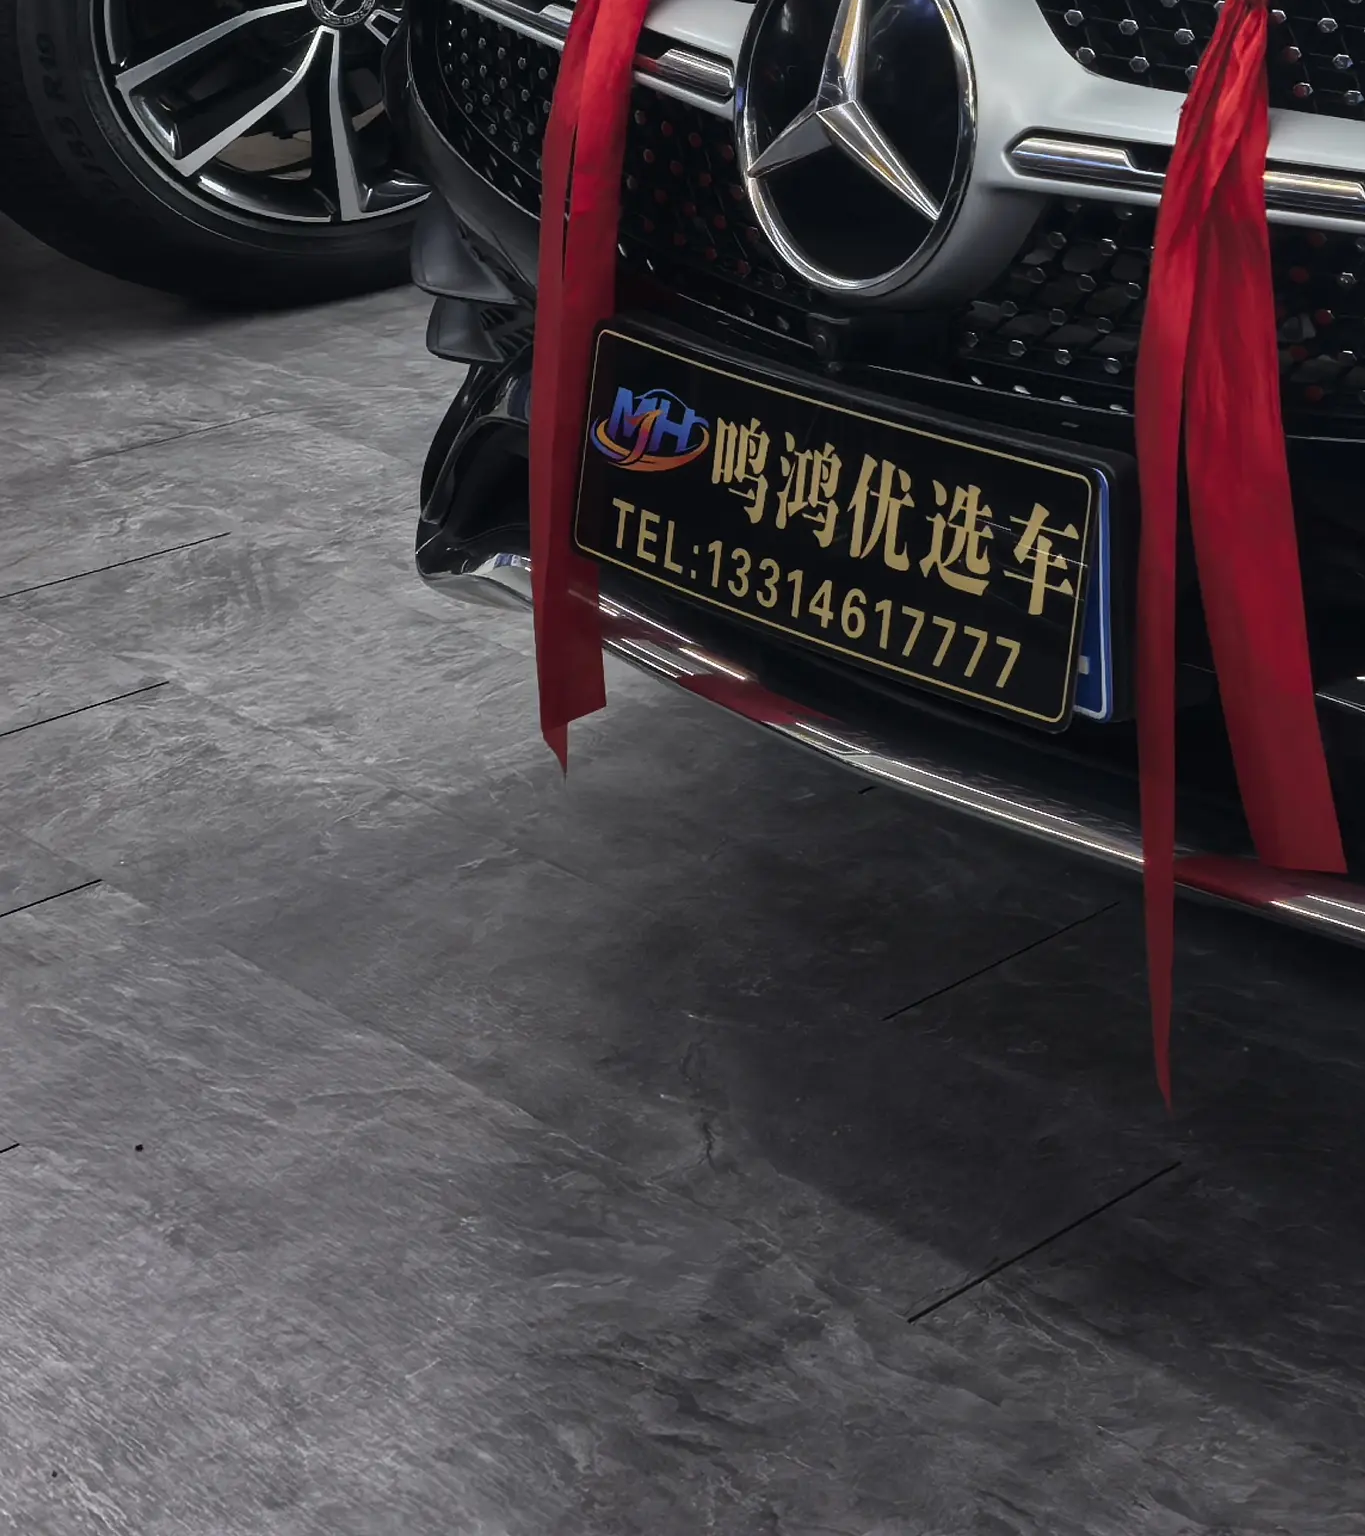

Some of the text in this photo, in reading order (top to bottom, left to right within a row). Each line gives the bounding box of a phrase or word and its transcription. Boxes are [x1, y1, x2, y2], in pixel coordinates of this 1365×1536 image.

[612, 497, 1022, 689] TEL:13314617777
[711, 417, 1080, 617] 鸣鸿优选车
